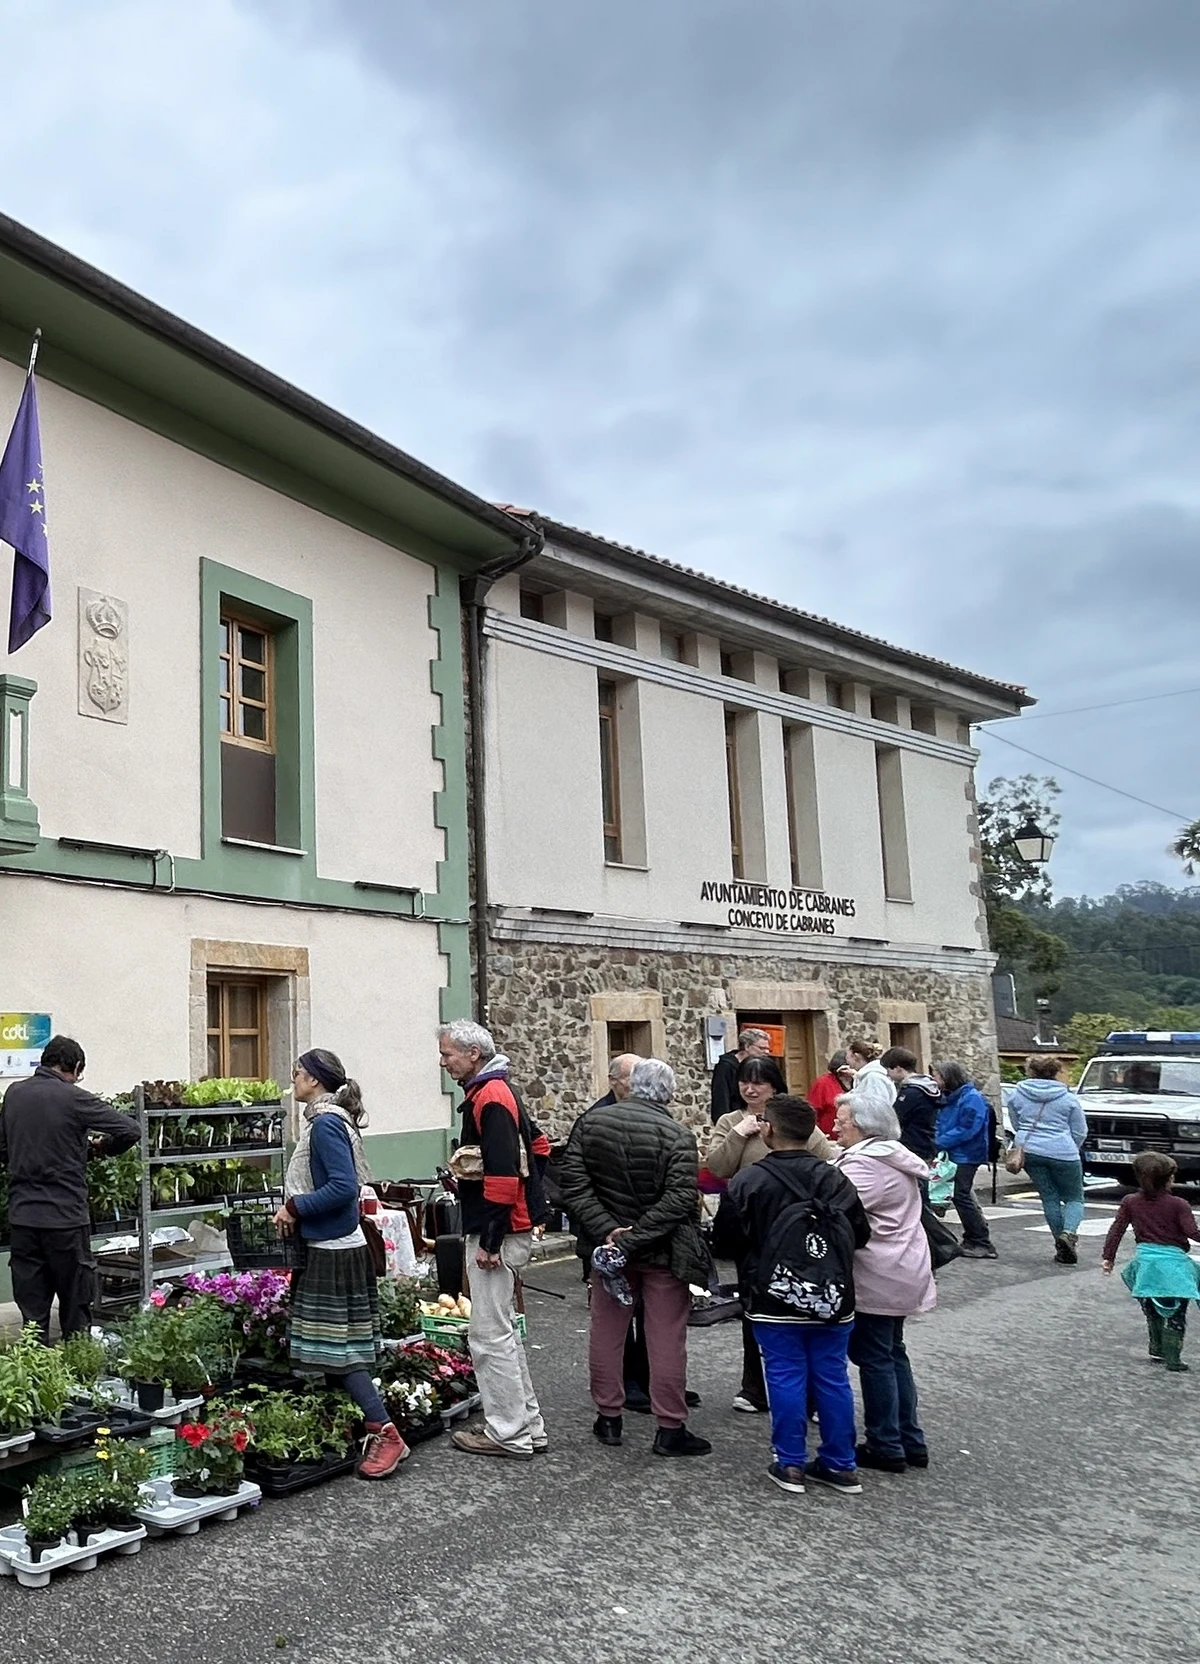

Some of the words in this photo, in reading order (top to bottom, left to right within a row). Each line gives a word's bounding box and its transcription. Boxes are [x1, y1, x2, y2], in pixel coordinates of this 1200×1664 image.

[701, 881, 787, 910] AYUNTAMIENTO
[789, 890, 804, 911] DE
[805, 893, 856, 917] CABRANES
[728, 908, 774, 930] CONCEYU
[775, 913, 789, 931] DE
[790, 914, 835, 935] CABRANES
